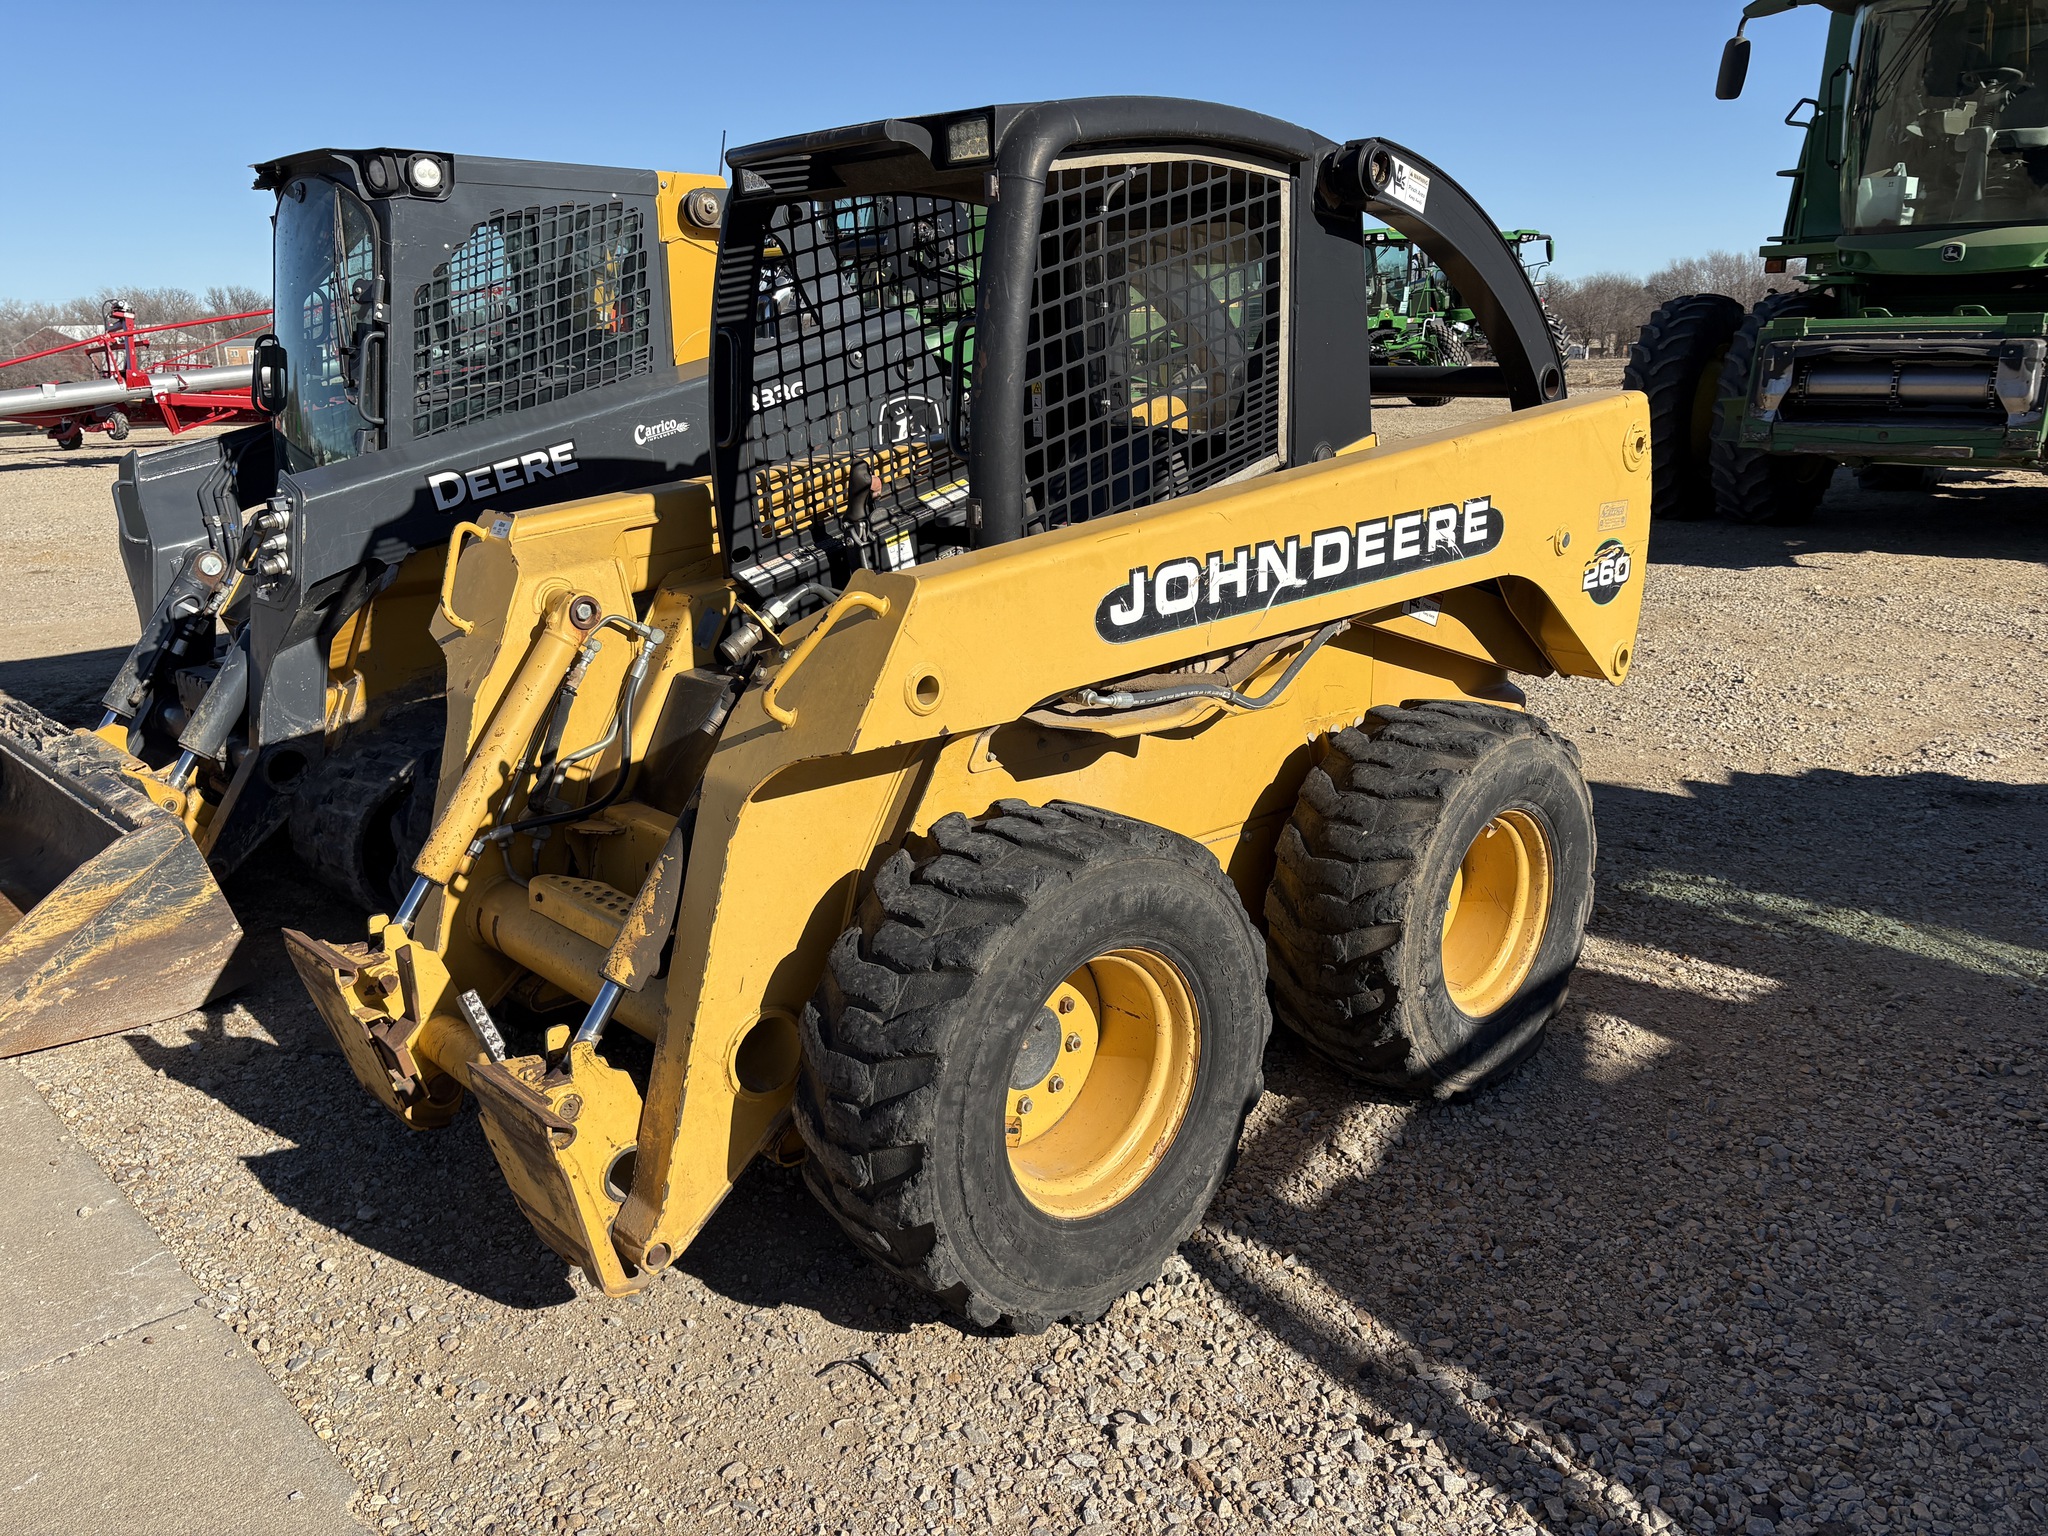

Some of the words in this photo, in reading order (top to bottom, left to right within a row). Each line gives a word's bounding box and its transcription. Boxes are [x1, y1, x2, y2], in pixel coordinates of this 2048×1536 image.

[634, 419, 677, 445] Carrico
[428, 441, 580, 511] DEERE
[1110, 541, 1303, 626] JOHN
[1313, 499, 1490, 580] DEERE
[1582, 555, 1631, 591] 260
